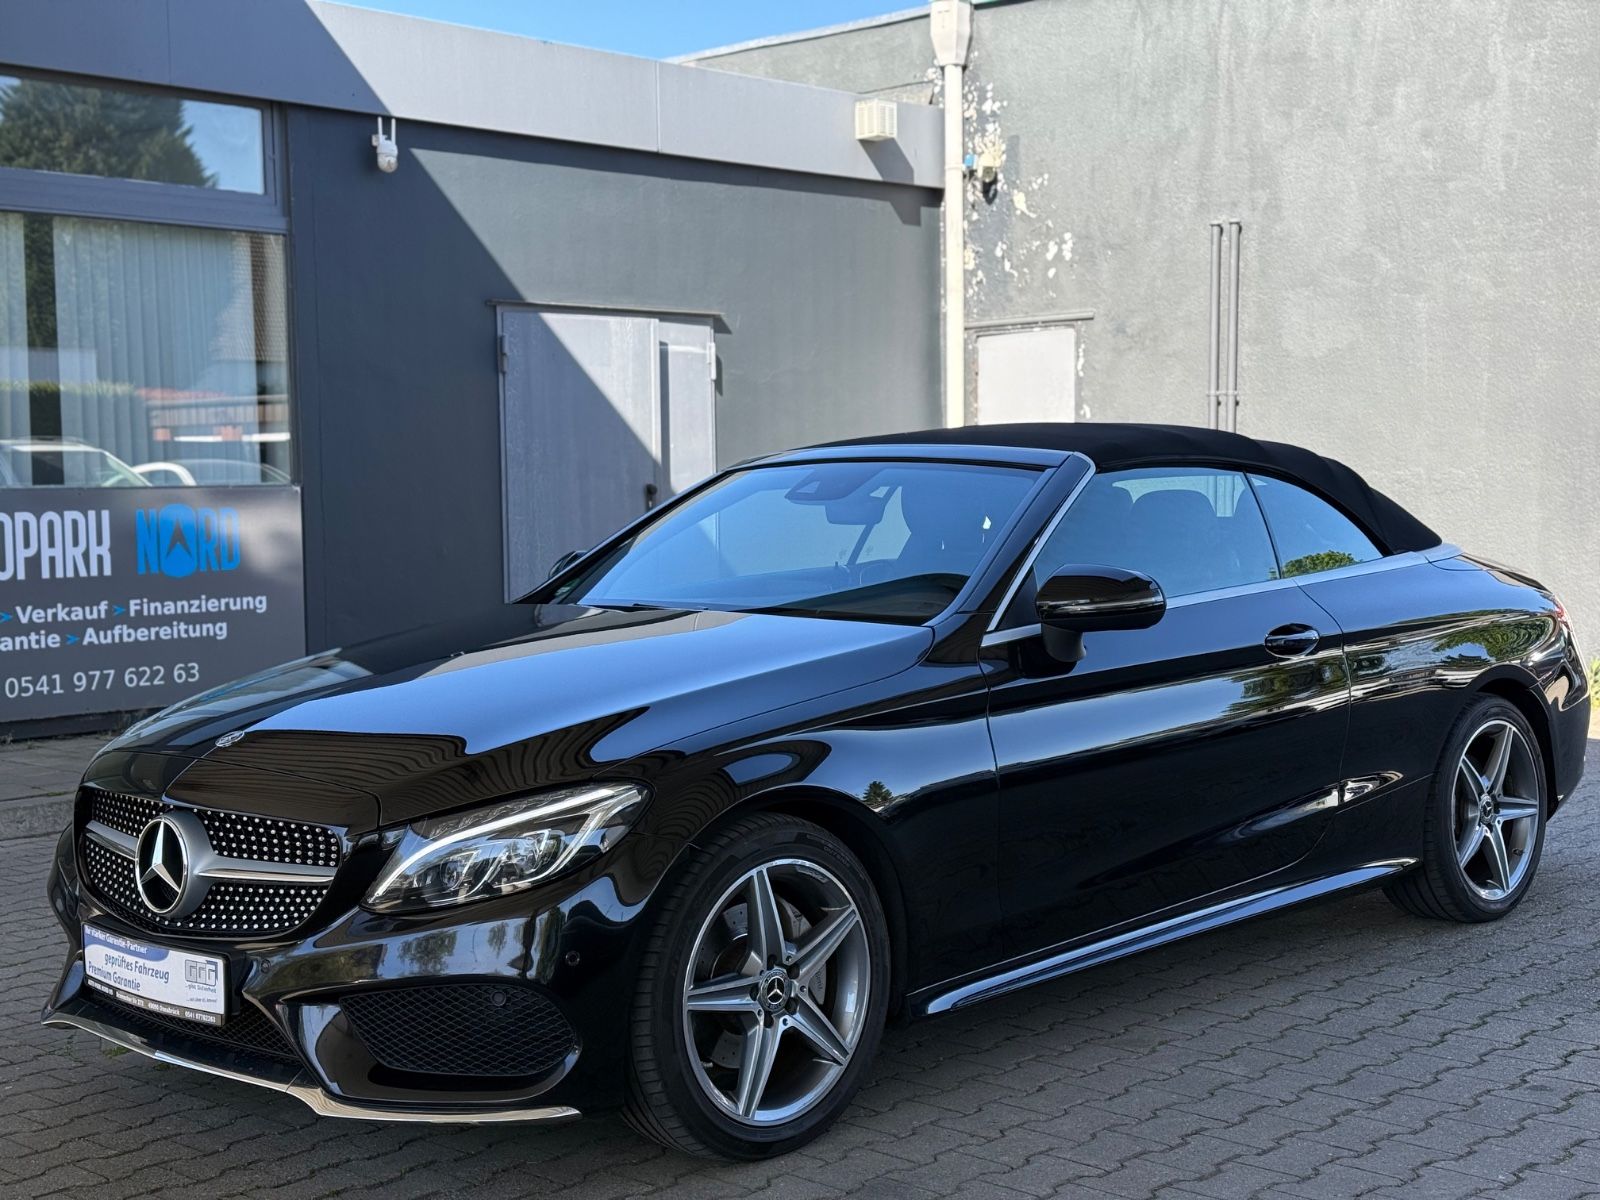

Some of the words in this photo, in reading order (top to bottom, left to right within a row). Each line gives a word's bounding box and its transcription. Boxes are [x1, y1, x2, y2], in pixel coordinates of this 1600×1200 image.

[135, 503, 241, 579] NORD
[15, 601, 108, 624] Verkauf
[129, 594, 267, 617] Finanzierung
[82, 621, 228, 646] Aufbereitung
[4, 674, 65, 698] 0541
[73, 669, 116, 692] 977
[124, 665, 165, 688] 622
[173, 662, 200, 683] 63
[88, 960, 112, 981] Premium
[112, 971, 141, 992] Garantie
[104, 953, 133, 972] geprüftes
[134, 960, 170, 984] Fahrzeug
